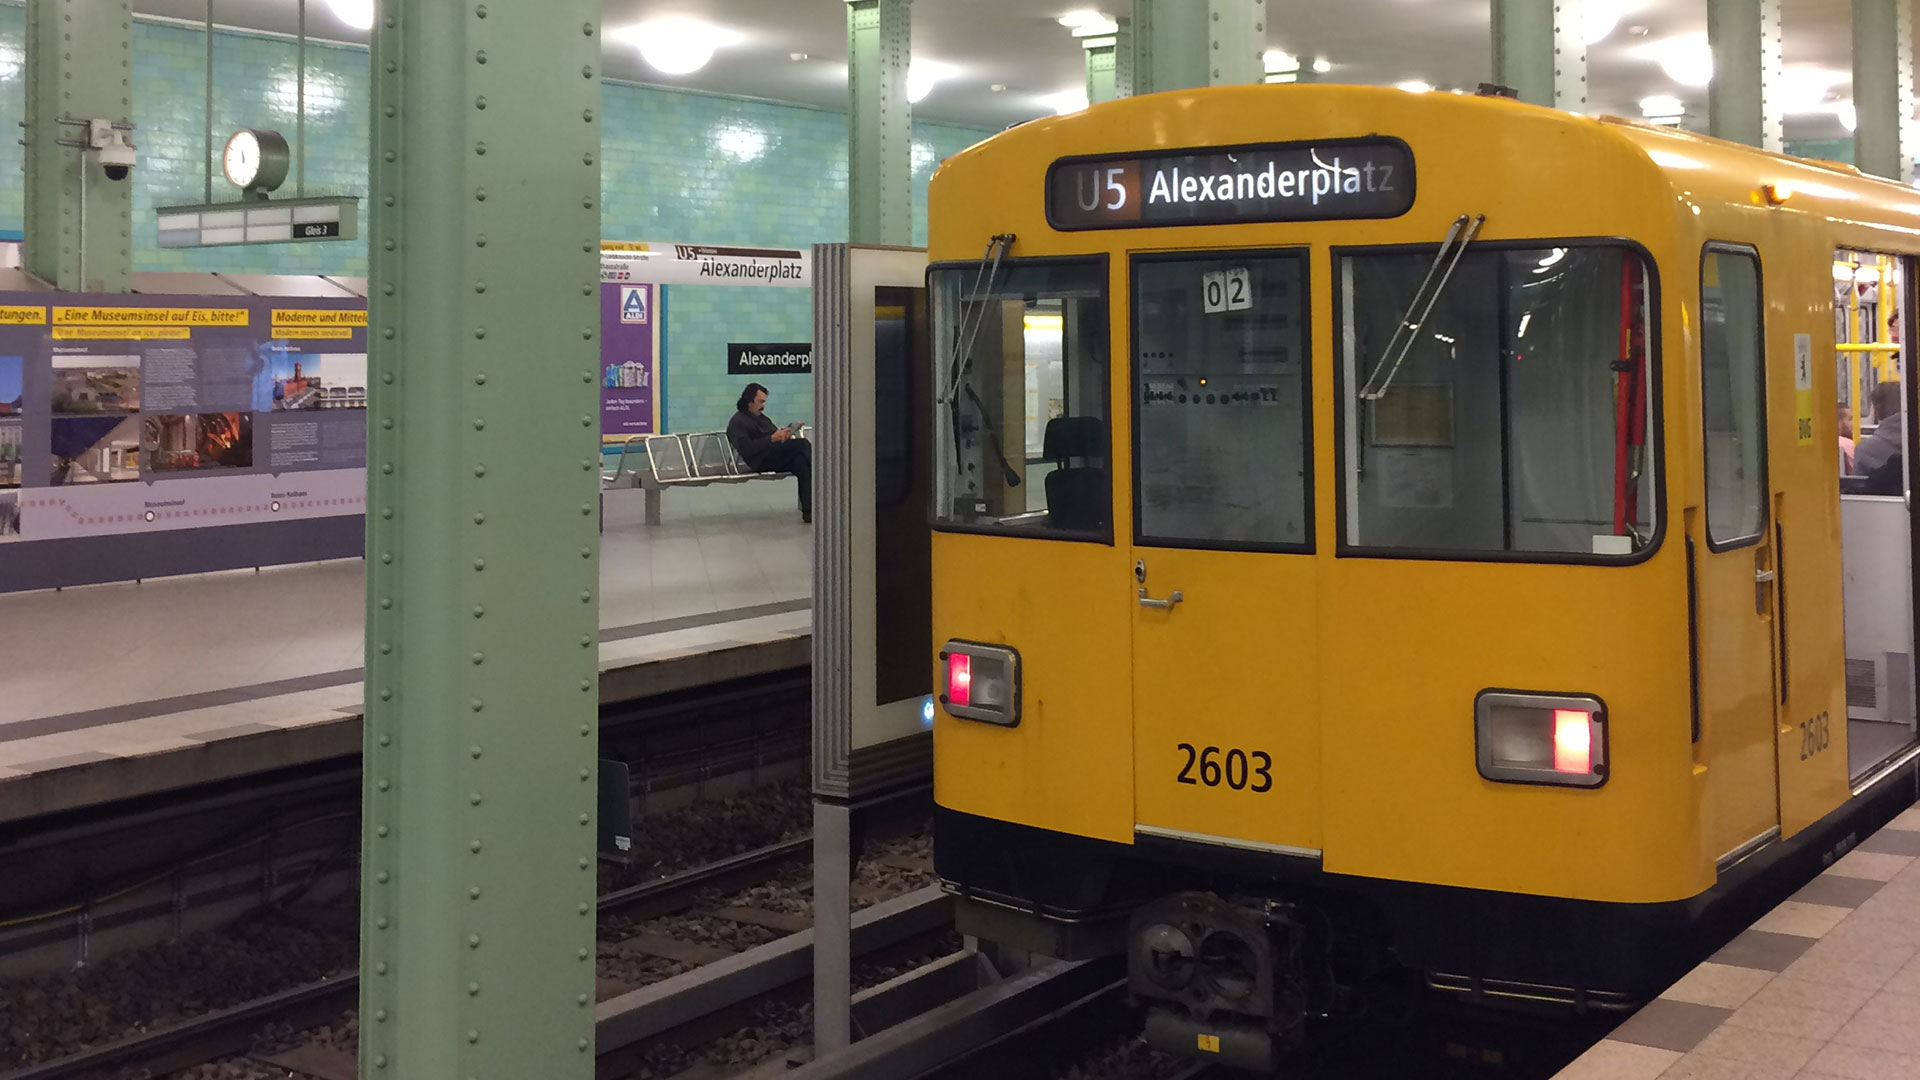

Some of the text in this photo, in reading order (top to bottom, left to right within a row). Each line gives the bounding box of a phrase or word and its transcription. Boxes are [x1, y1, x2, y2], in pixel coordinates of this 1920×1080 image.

[1077, 158, 1394, 212] U5 Alexanderplatz
[305, 224, 328, 236] Gleis 3
[677, 246, 697, 260] U5
[700, 258, 802, 282] Alexanderplatz
[91, 310, 169, 322] Museumsinsel
[171, 310, 190, 322] auf
[191, 311, 209, 323] Eis,
[276, 311, 317, 323] Moderne
[319, 312, 337, 323] und
[625, 312, 644, 320] ALDI
[739, 351, 812, 368] Alexanderpl
[1800, 711, 1830, 761] 2603
[1177, 743, 1273, 793] 2603
